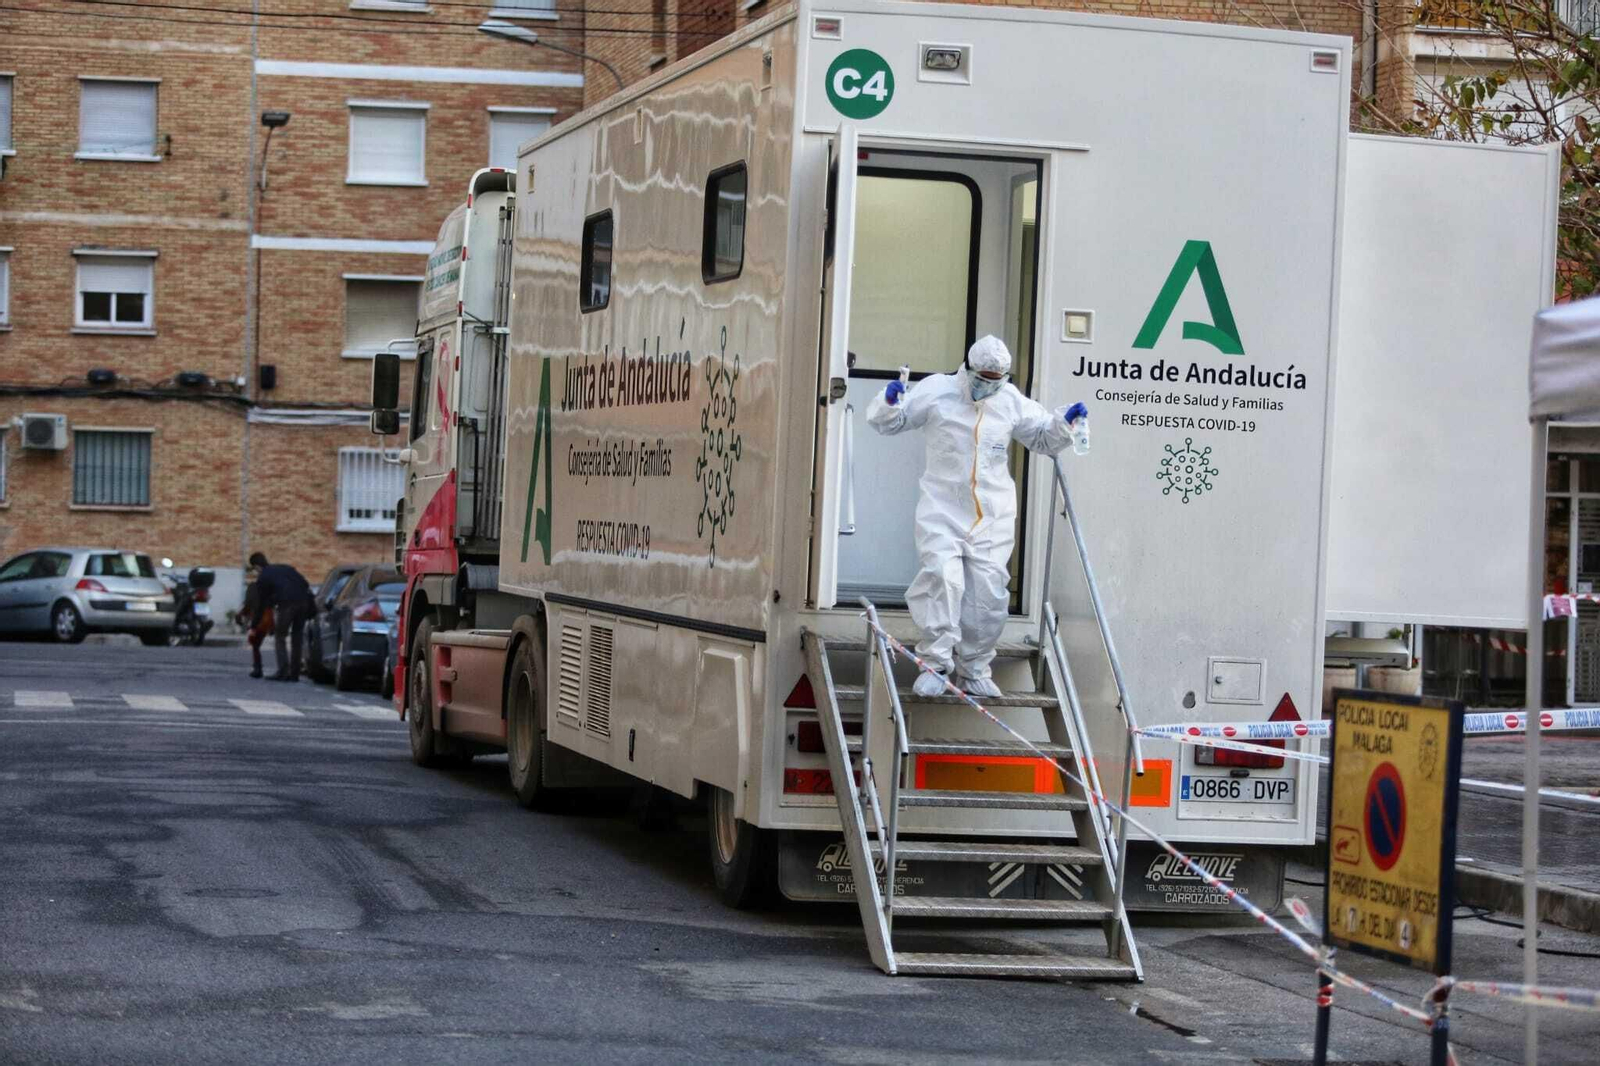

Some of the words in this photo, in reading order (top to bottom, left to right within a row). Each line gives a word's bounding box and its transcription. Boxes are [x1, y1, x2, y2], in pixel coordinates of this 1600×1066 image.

[833, 67, 888, 102] C4
[561, 355, 595, 412] Junta
[599, 345, 615, 408] de
[617, 317, 691, 407] Andalucía
[1072, 356, 1142, 380] Junta
[1150, 359, 1179, 382] de
[1185, 363, 1307, 389] Andalucía
[1095, 389, 1162, 405] Consejería
[1165, 392, 1180, 405] de
[1183, 394, 1219, 408] Salud
[1221, 398, 1230, 410] y
[1232, 396, 1284, 411] Familias
[1121, 414, 1195, 429] RESPUESTA
[1198, 418, 1256, 432] COVID-19
[568, 438, 602, 485] Consejería
[602, 441, 611, 477] de
[612, 443, 632, 477] Salud
[633, 452, 639, 487] y
[640, 438, 672, 477] Familias
[576, 520, 615, 555] RESPUESTA
[616, 522, 650, 560] COVID-19
[1338, 704, 1375, 726] POLICIA
[1463, 715, 1485, 731] OLICIA
[1248, 724, 1273, 738] POLICIA
[1274, 723, 1294, 737] LOCAL
[1193, 779, 1241, 798] 0866
[1254, 781, 1289, 799] DVP
[1165, 893, 1230, 905] CARROZADOS
